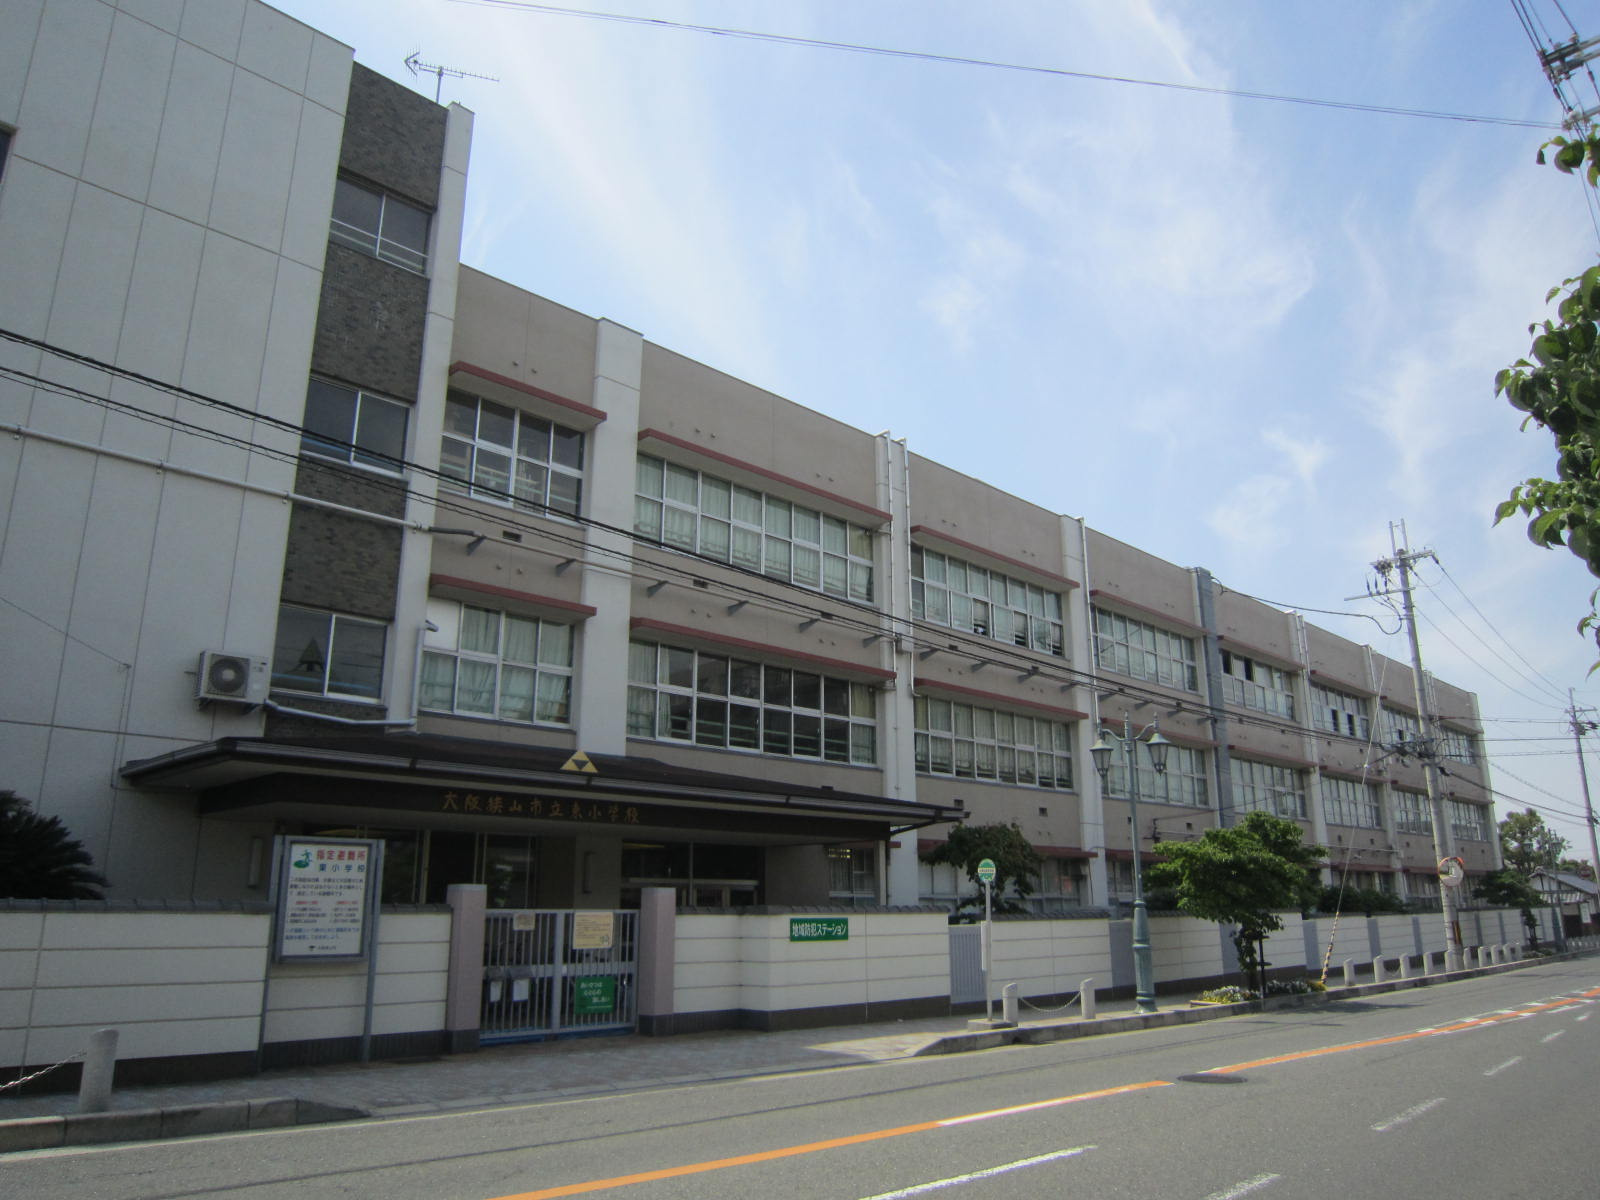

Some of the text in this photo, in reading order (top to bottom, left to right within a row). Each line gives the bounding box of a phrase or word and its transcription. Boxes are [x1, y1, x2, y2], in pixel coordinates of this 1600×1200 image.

[317, 849, 366, 861] 指定避難所
[792, 922, 847, 937] 地域防犯ステーション
